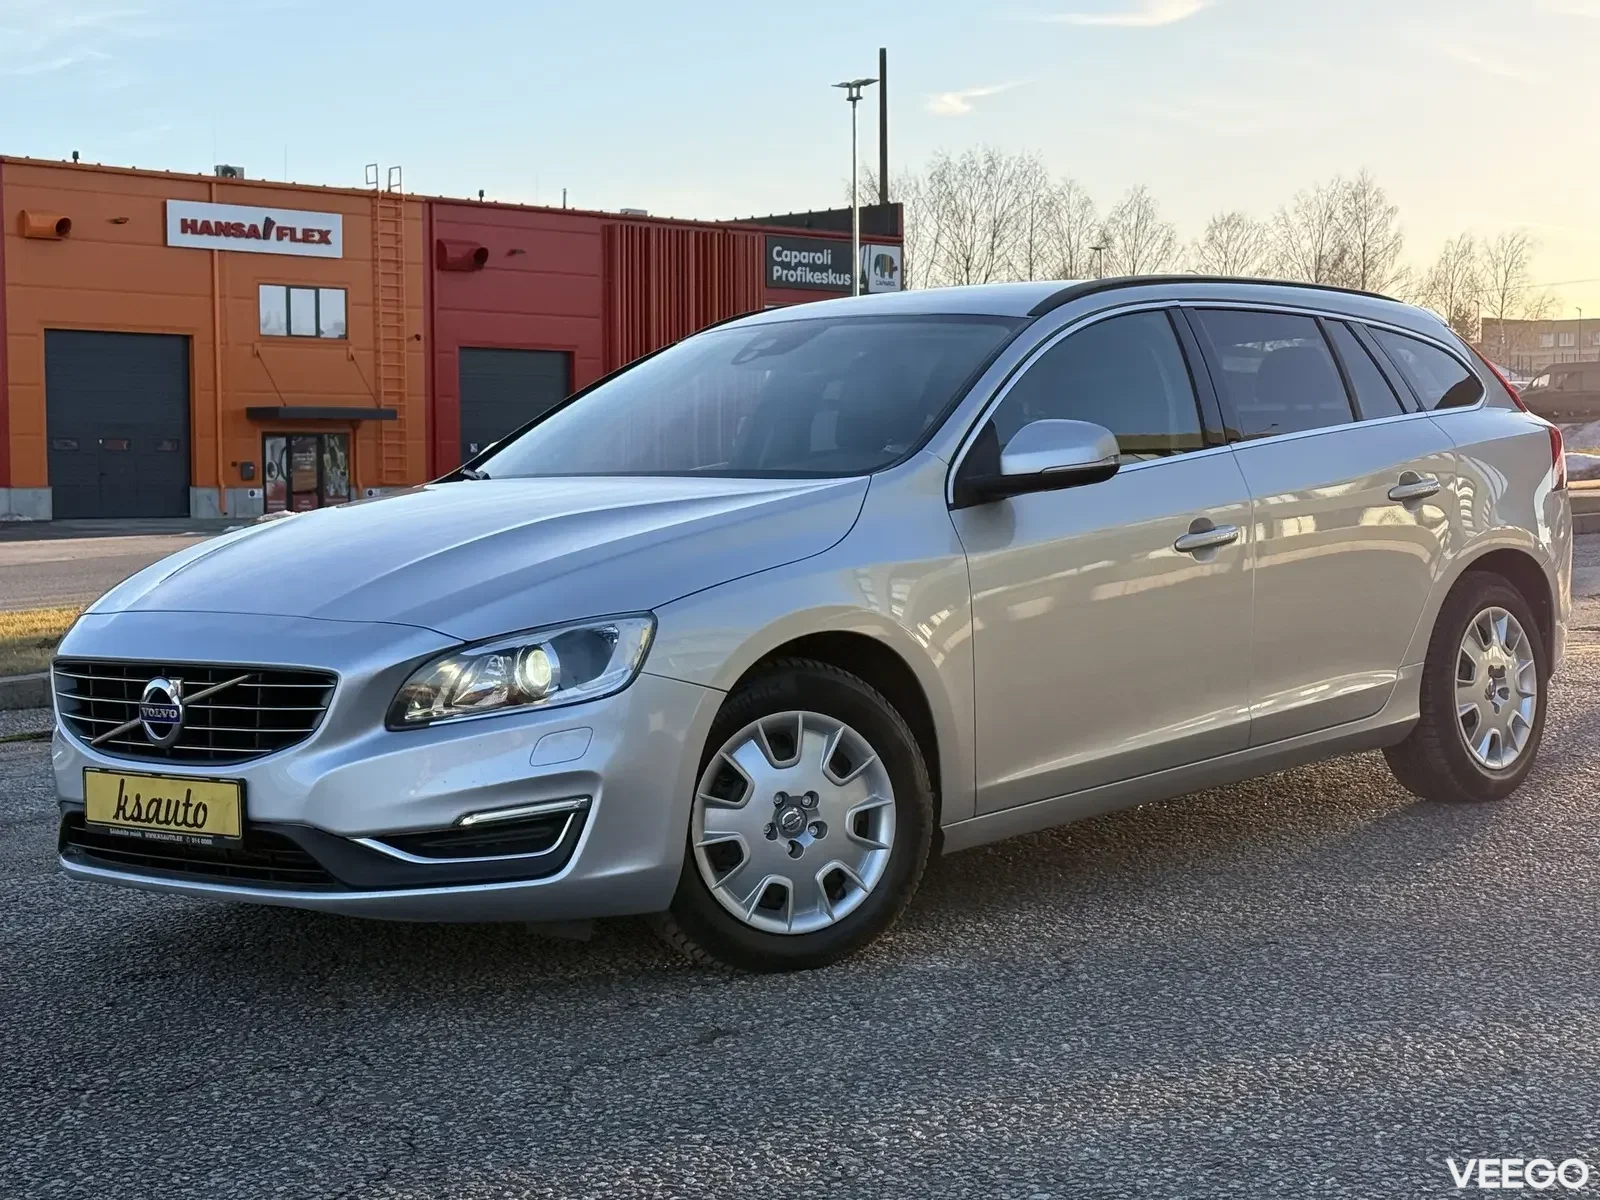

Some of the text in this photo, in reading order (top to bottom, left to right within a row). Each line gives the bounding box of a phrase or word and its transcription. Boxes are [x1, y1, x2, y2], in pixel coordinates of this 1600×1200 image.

[180, 218, 332, 245] HANSA FLEX
[772, 246, 832, 266] Caparoli
[772, 266, 852, 286] Profikeskus
[141, 707, 178, 719] VOLVO
[112, 778, 208, 829] ksauto
